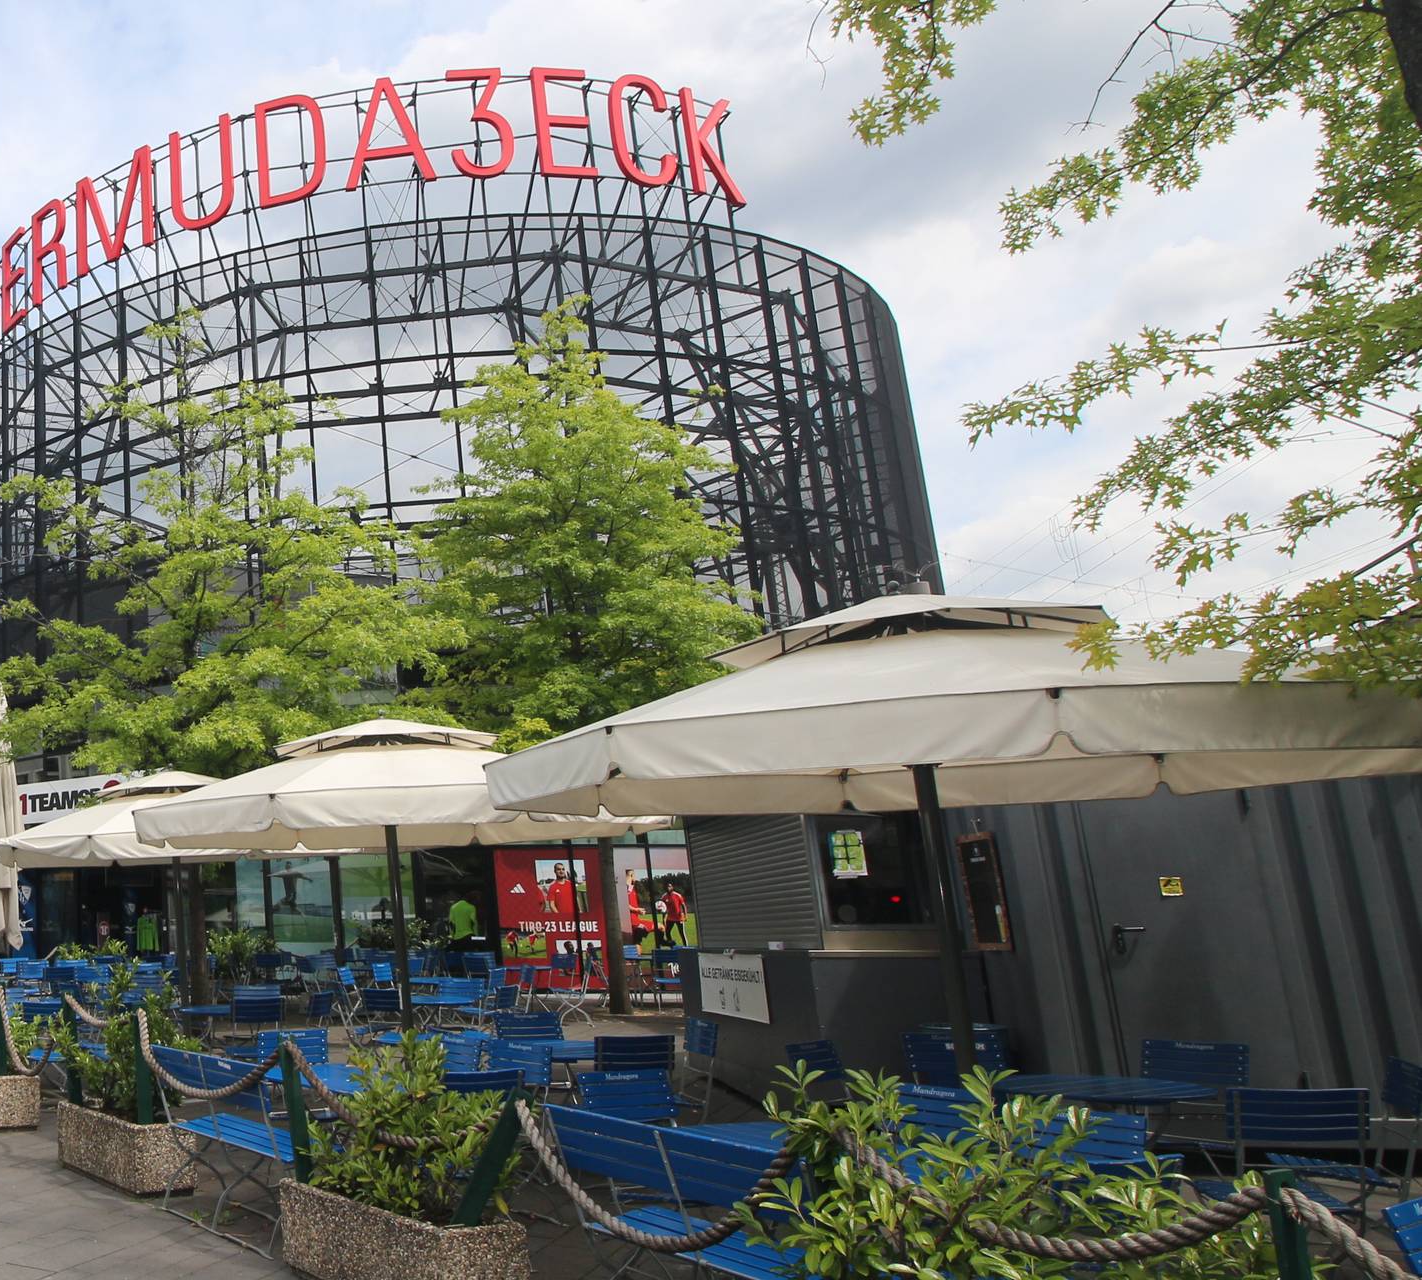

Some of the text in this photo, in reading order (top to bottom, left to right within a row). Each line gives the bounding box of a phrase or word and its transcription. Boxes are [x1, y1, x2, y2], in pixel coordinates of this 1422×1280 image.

[544, 921, 557, 932] 23
[559, 921, 599, 932] LEAGUE
[605, 1072, 639, 1081] Mandragora
[912, 1085, 956, 1099] Mandragora
